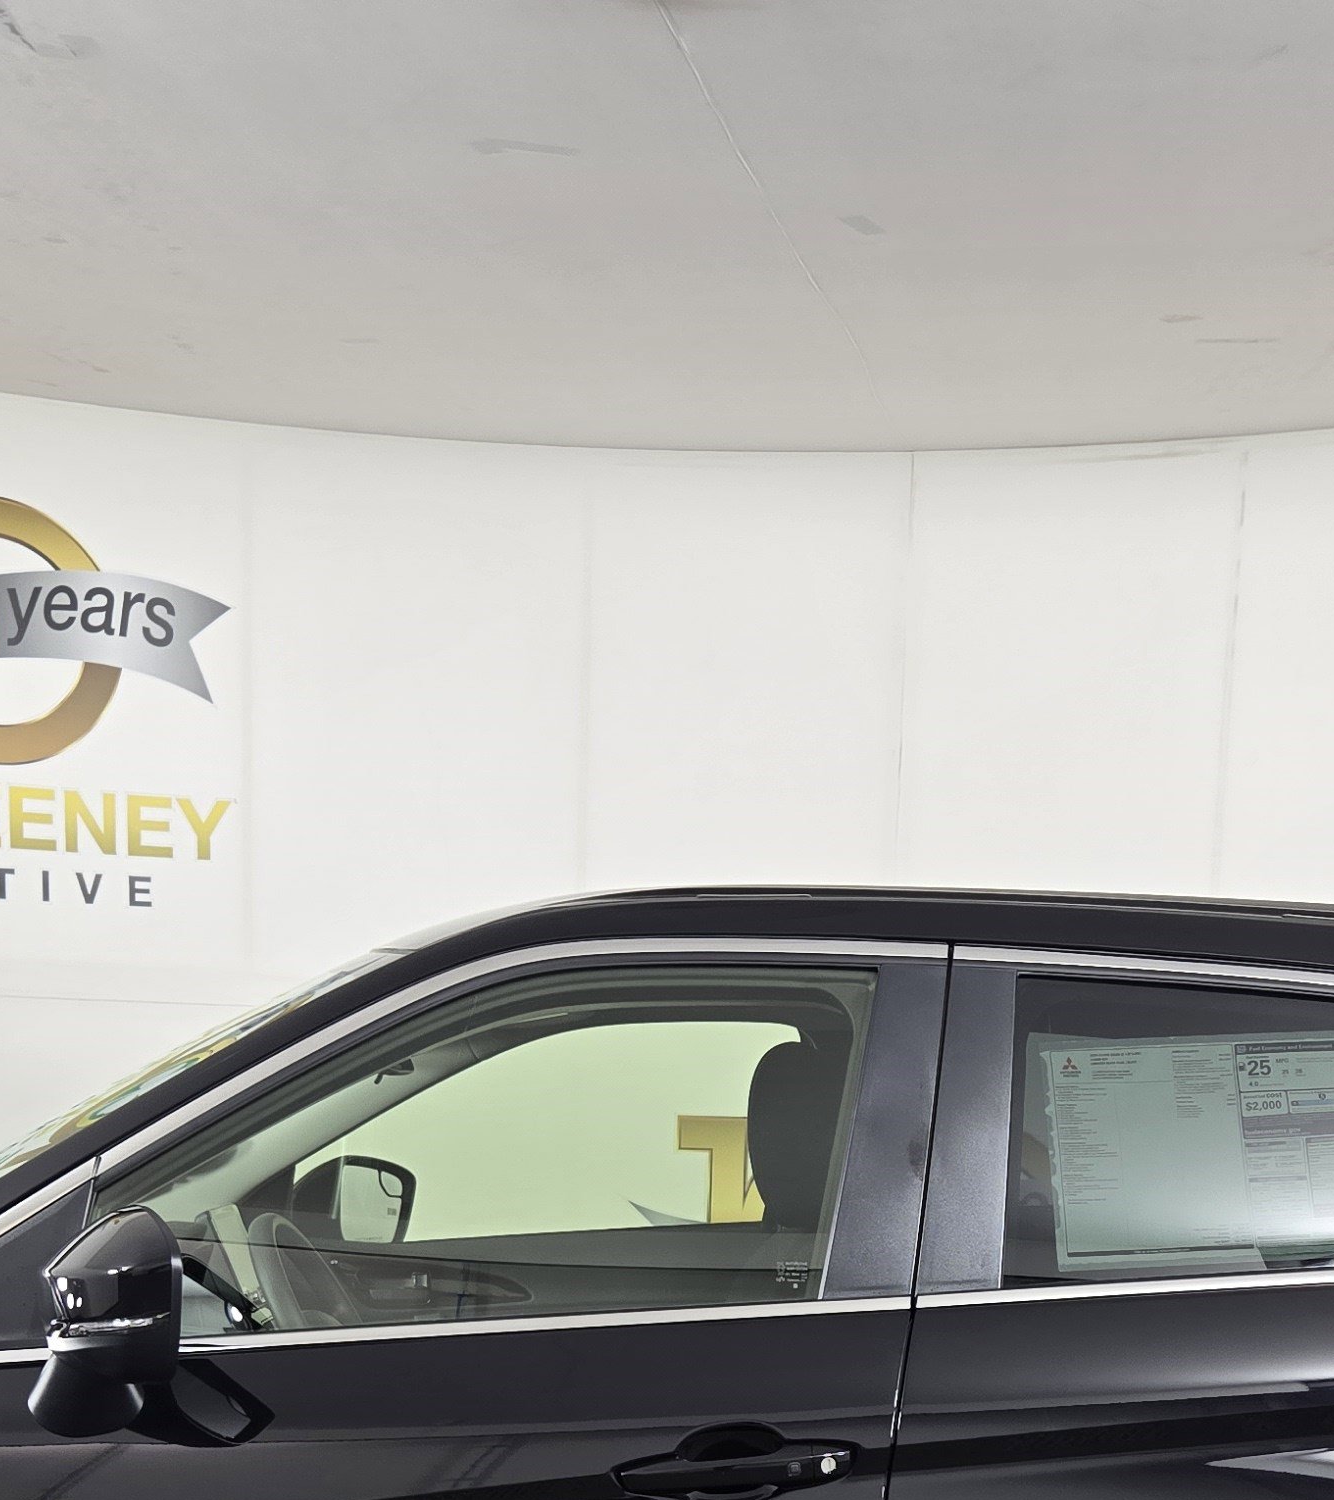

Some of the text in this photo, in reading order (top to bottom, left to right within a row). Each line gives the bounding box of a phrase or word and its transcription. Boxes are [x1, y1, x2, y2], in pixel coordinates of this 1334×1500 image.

[6, 577, 177, 648] years
[1247, 1059, 1272, 1076] 25
[1245, 1100, 1282, 1111] $2,000
